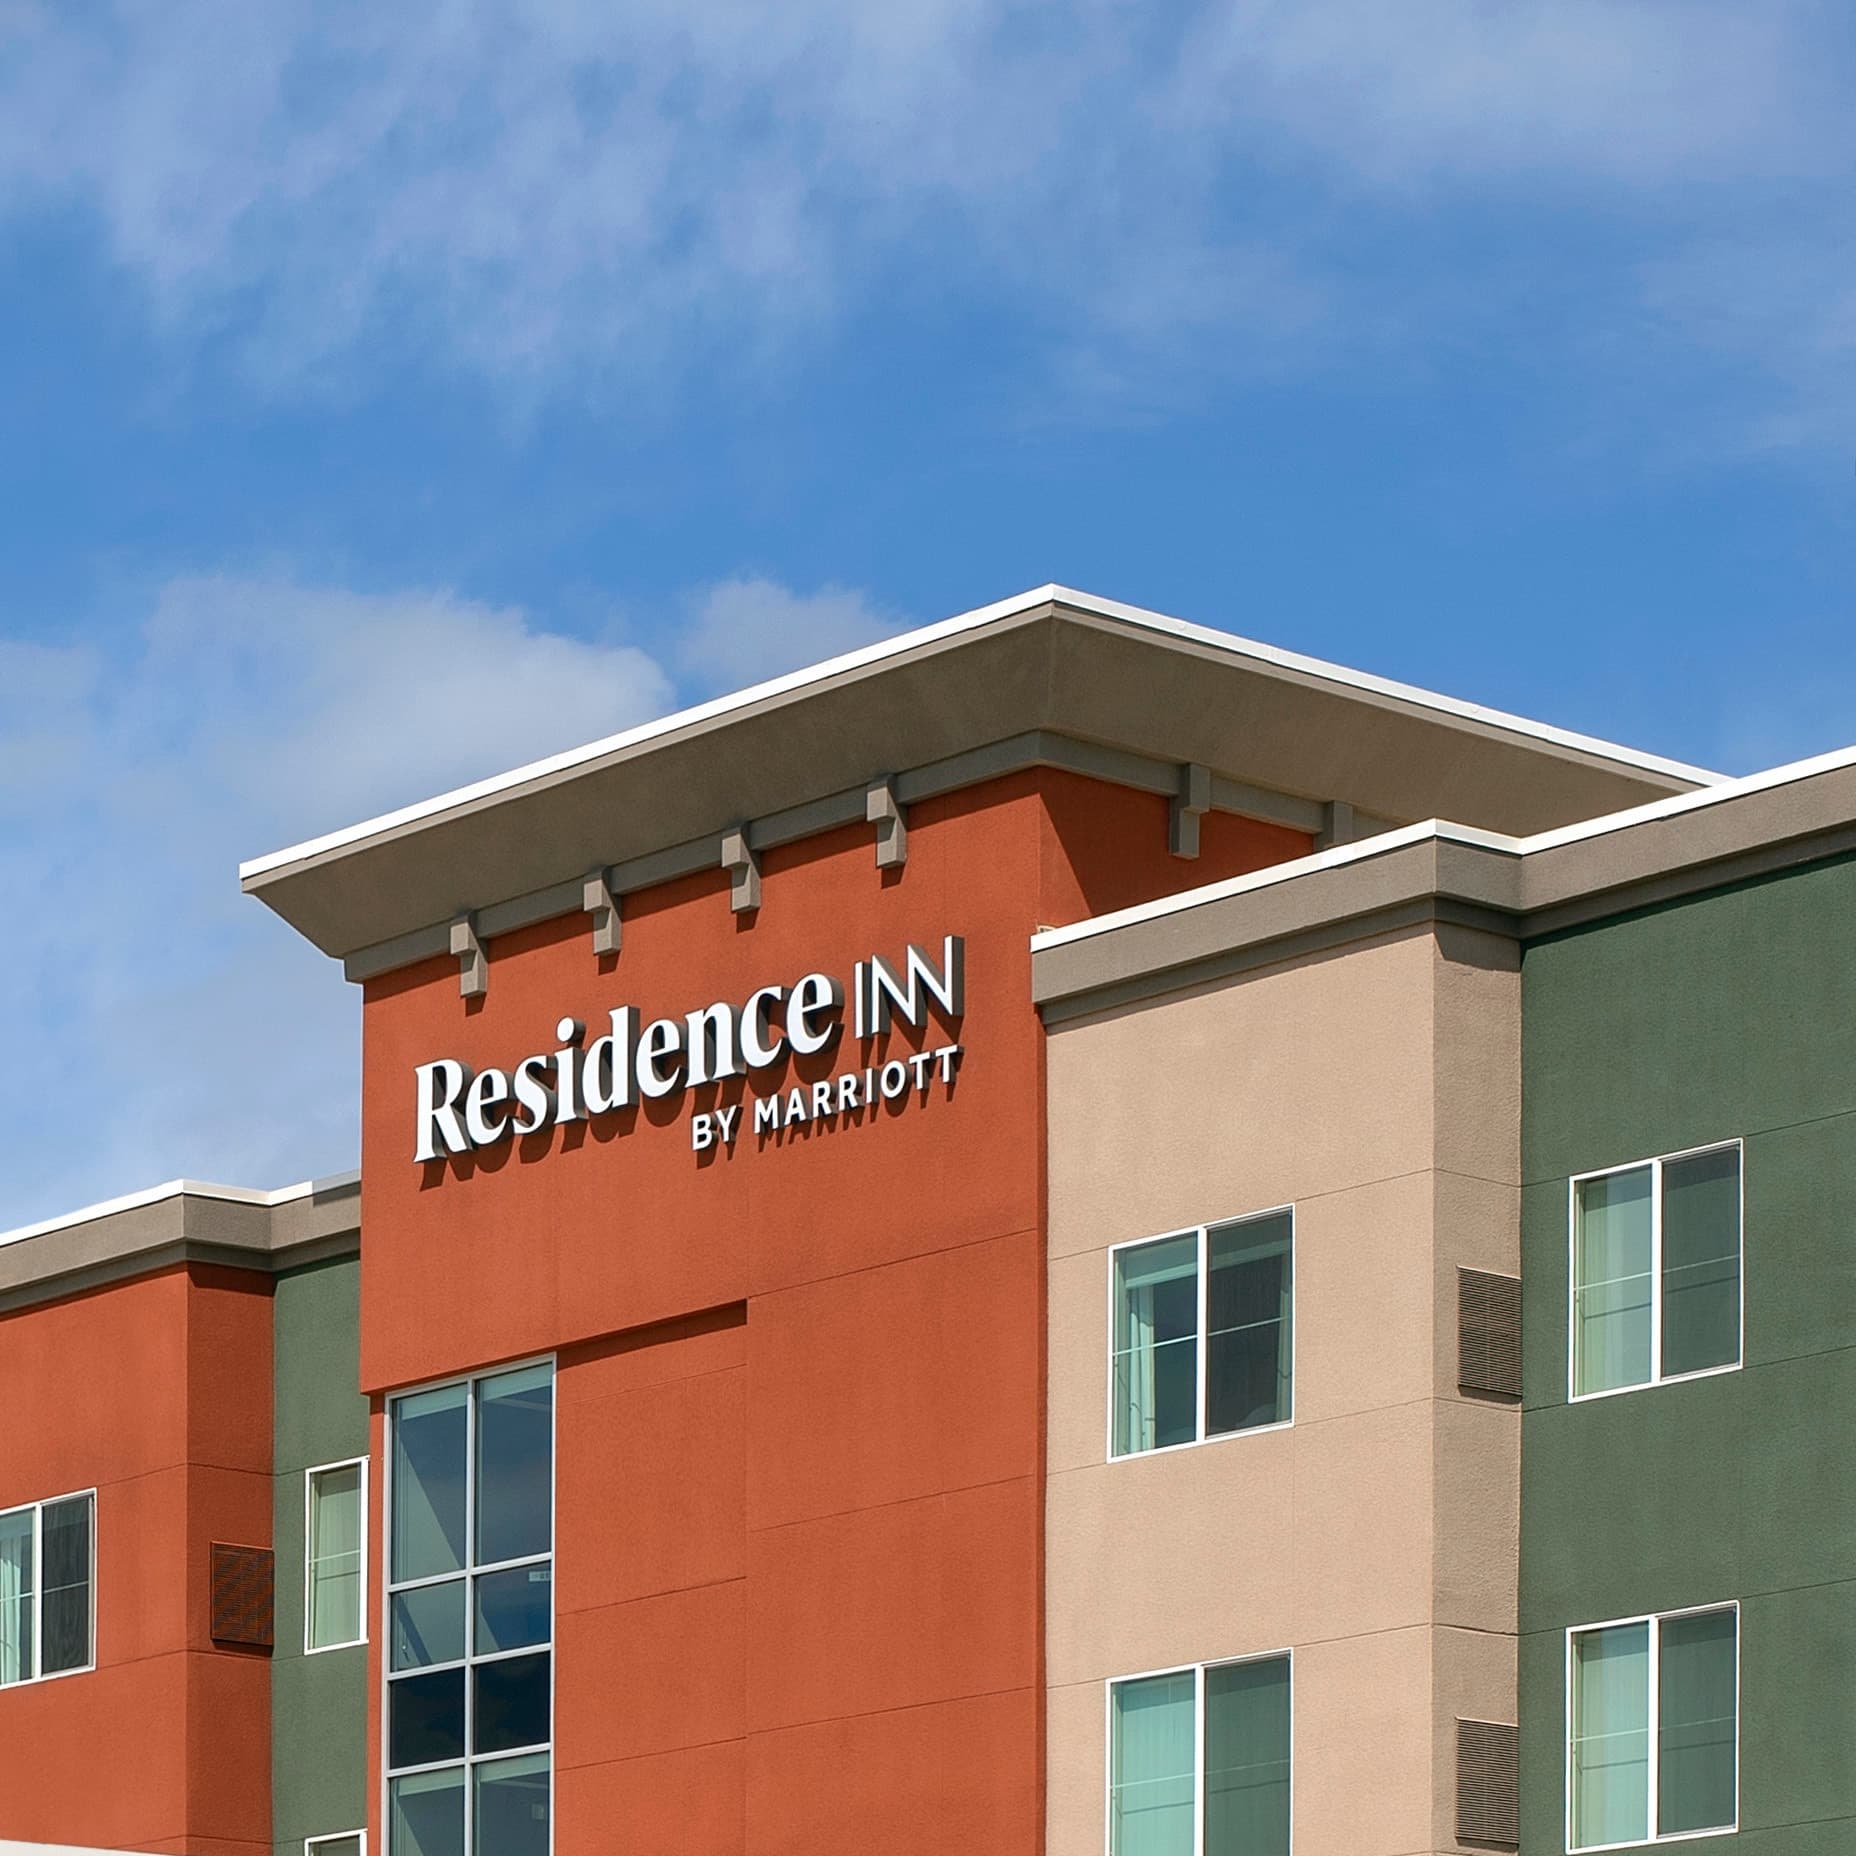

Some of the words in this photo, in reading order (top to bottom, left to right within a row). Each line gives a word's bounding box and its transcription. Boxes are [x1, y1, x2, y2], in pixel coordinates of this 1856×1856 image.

[413, 972, 836, 1163] Residence
[855, 934, 960, 1040] INN
[692, 1104, 738, 1152] BY
[753, 1043, 961, 1135] MARRIOTT
